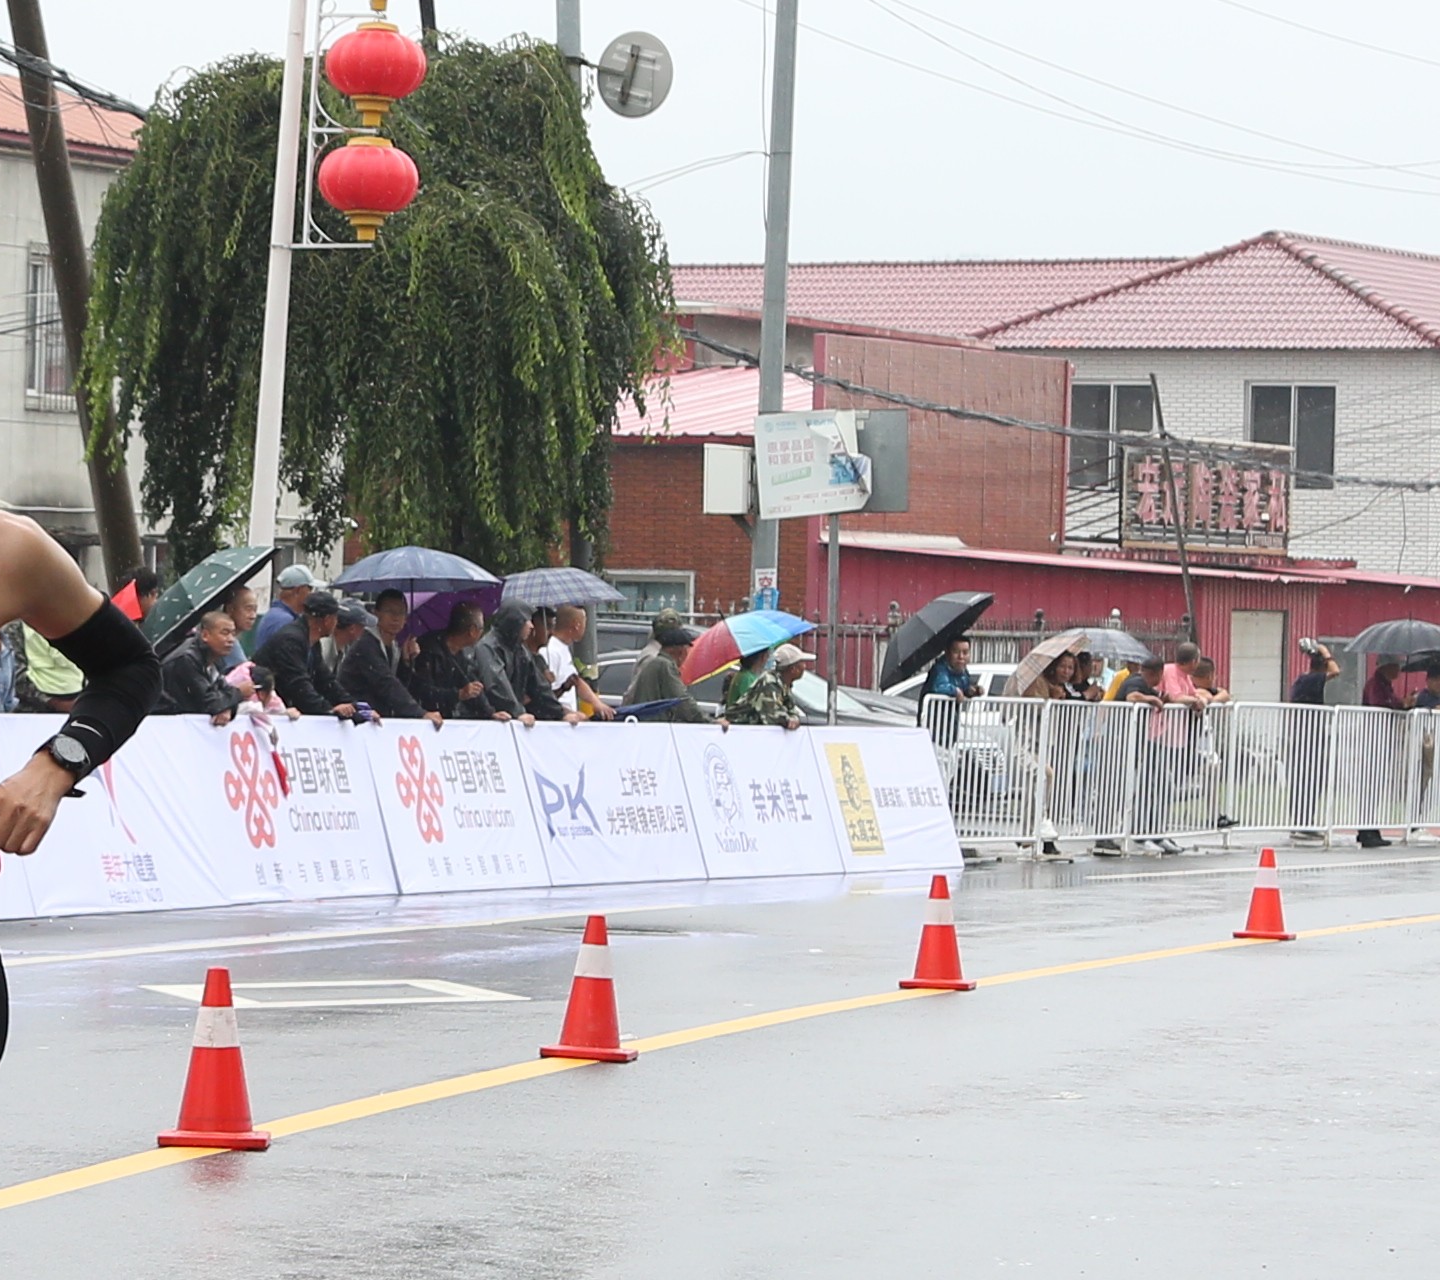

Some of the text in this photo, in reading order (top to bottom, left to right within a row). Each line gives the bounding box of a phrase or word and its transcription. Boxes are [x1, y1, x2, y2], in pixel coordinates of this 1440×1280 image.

[440, 749, 507, 795] 中国联通
[533, 762, 604, 844] PK
[749, 778, 813, 824] 奈米博士
